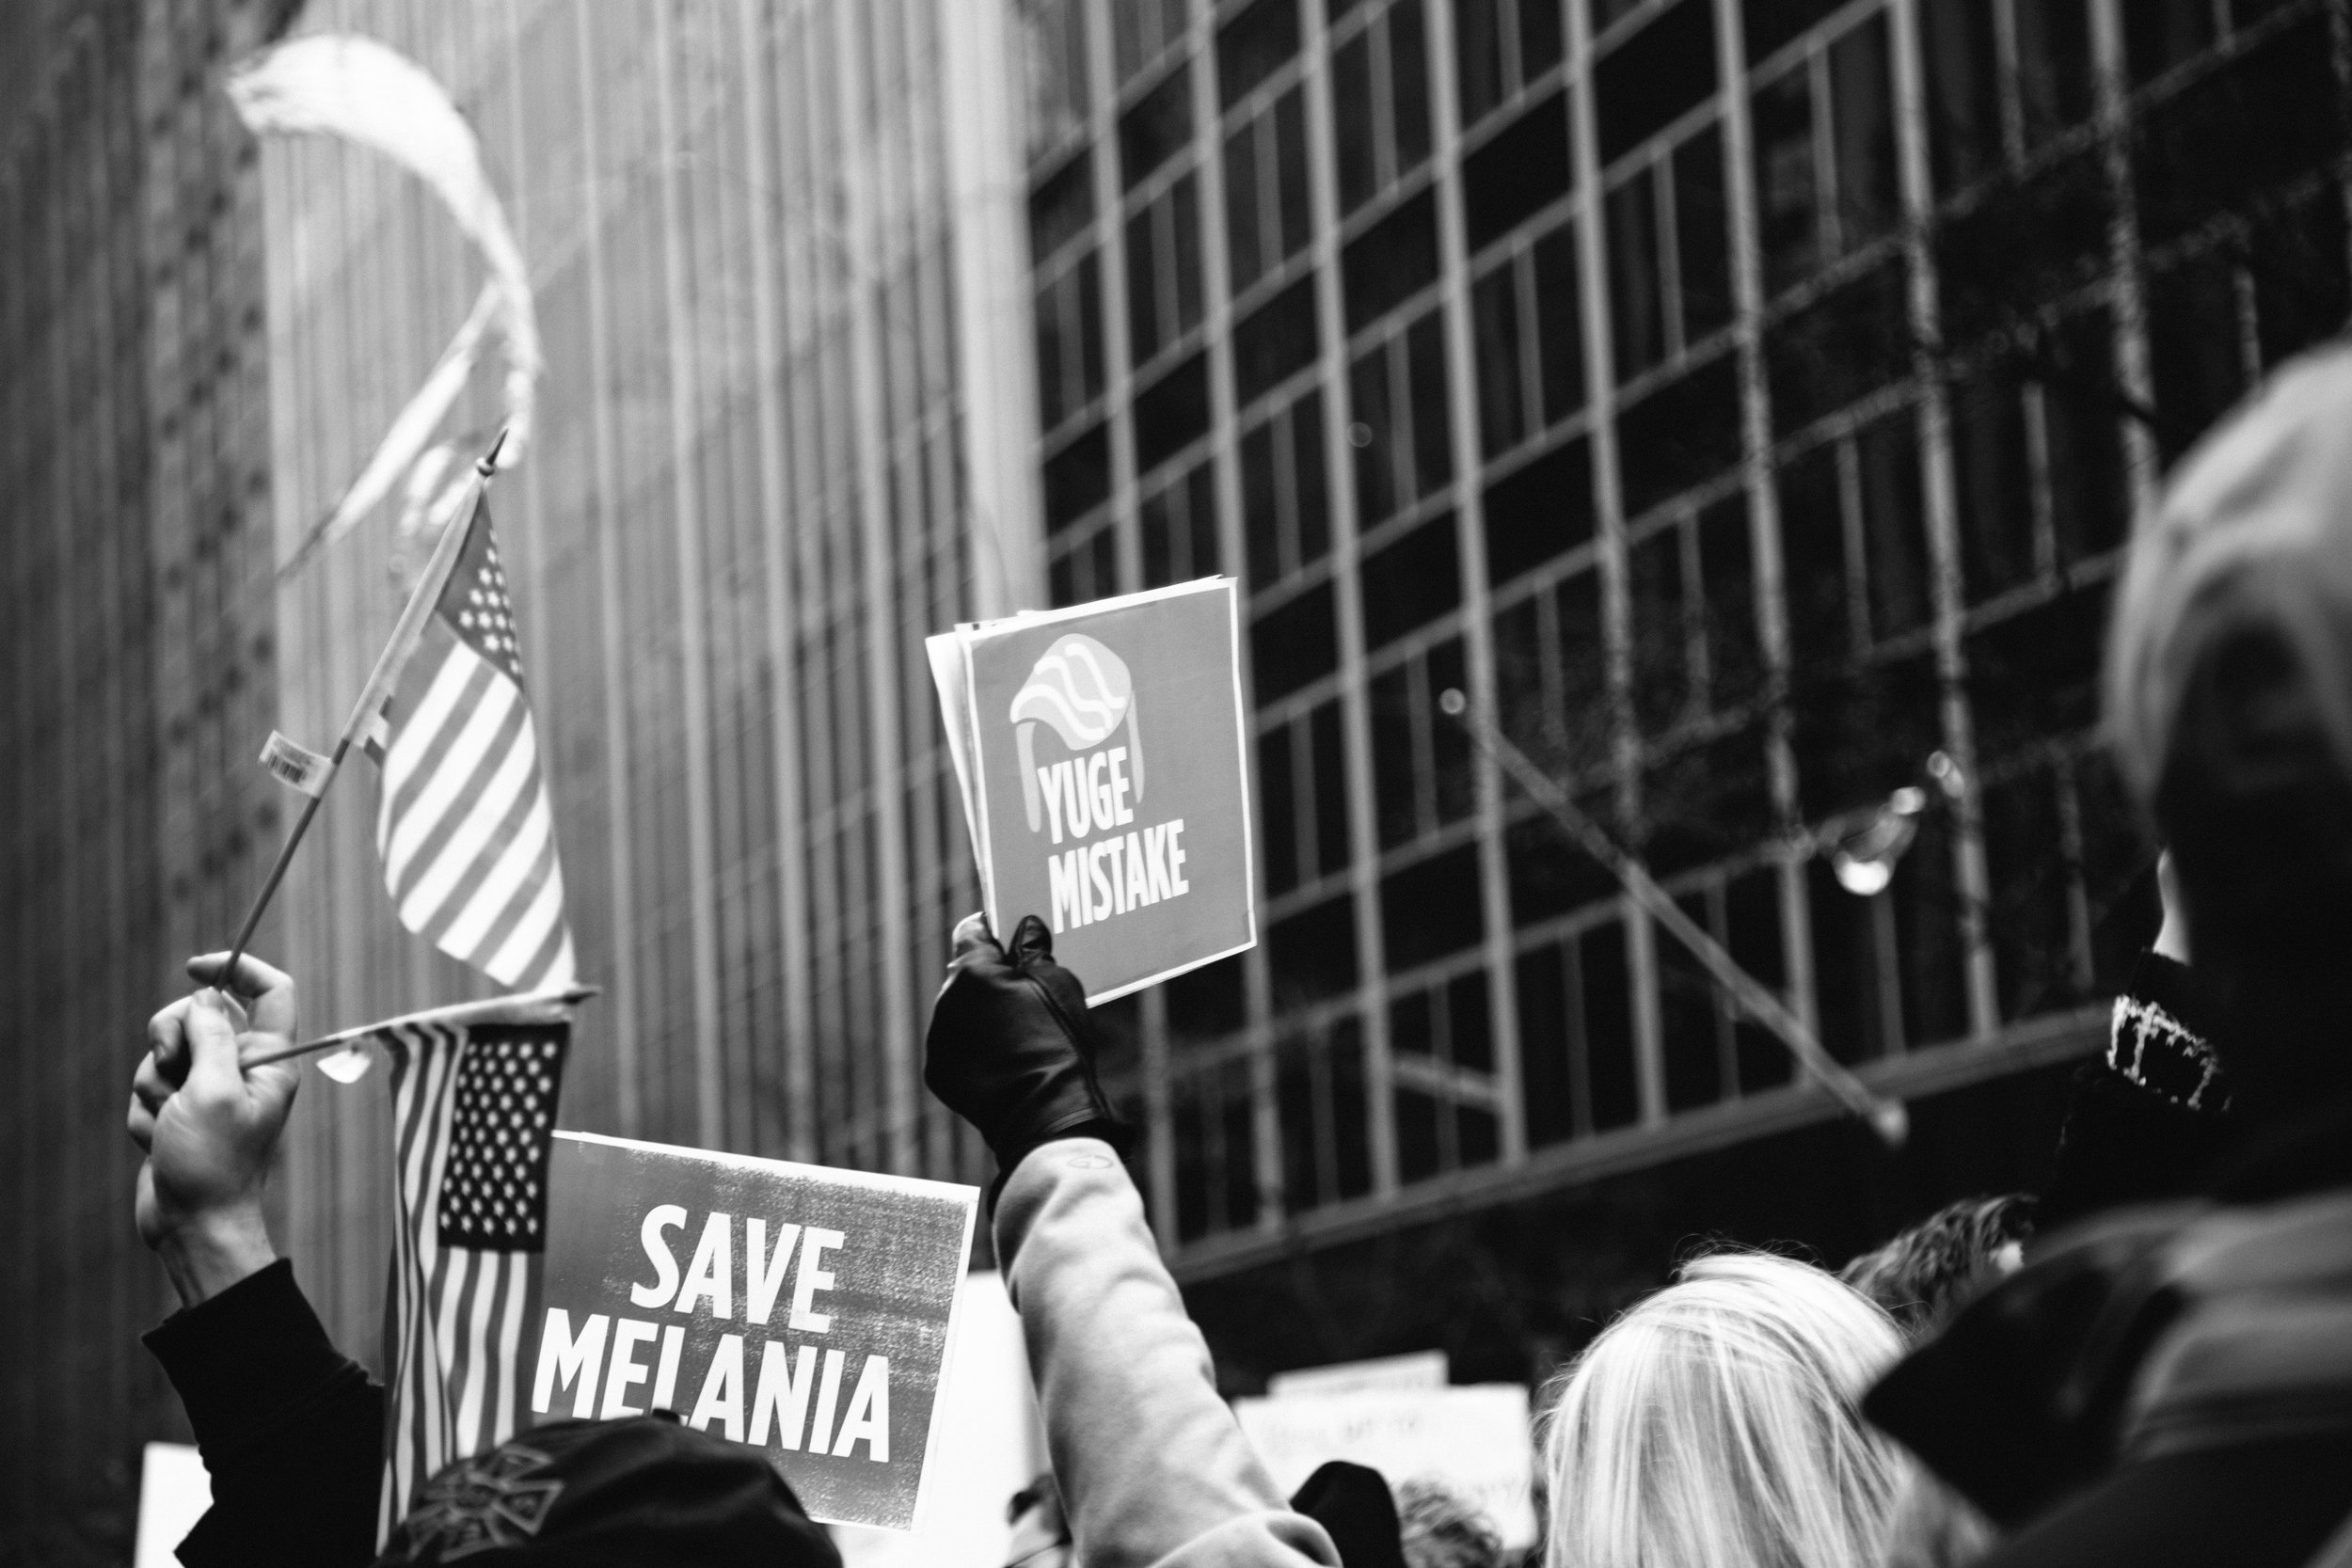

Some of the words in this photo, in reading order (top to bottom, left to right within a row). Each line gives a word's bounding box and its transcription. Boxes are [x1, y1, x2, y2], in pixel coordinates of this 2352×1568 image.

[1037, 746, 1134, 845] YUGE
[1048, 818, 1189, 934] MISTAKE
[629, 1204, 846, 1334] SAVE
[532, 1307, 890, 1464] MELANIA
